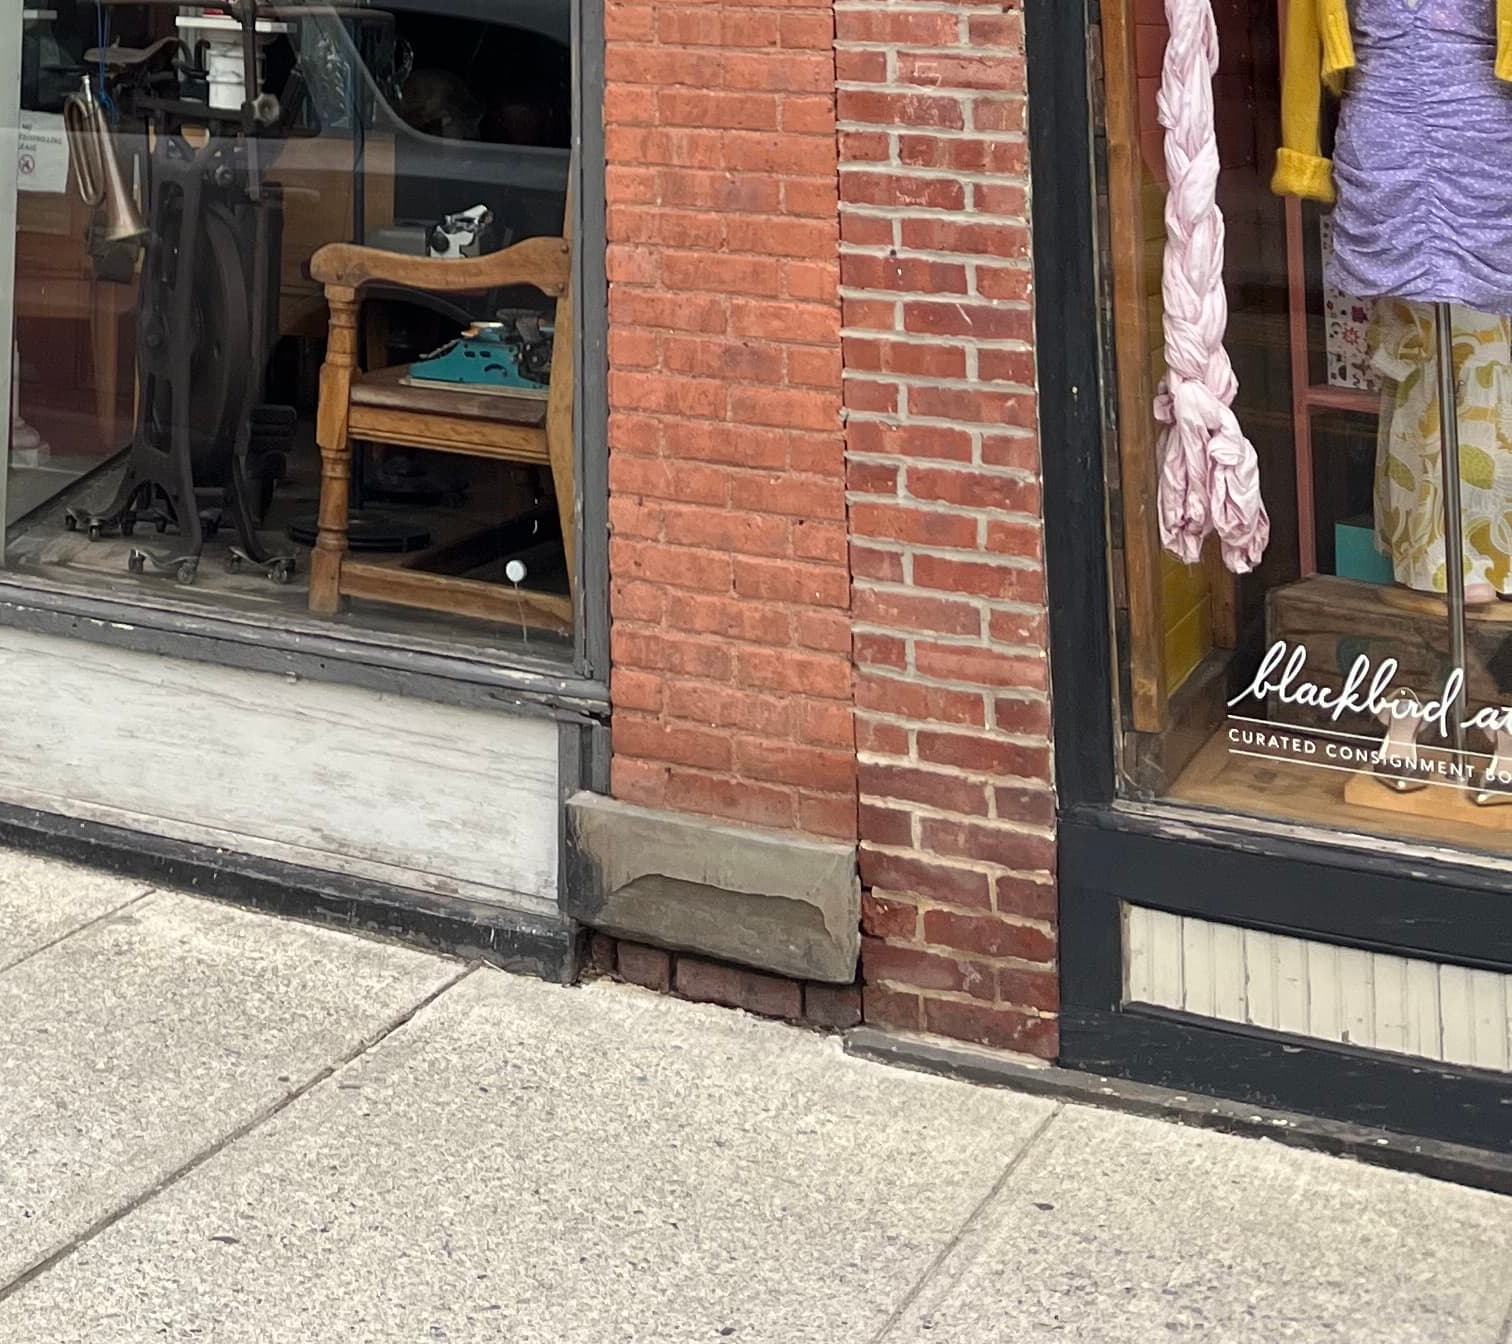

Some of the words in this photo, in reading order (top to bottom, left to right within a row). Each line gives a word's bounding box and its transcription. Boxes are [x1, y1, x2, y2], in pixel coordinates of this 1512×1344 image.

[1227, 640, 1464, 737] blackbird
[1228, 728, 1317, 755] CURATED
[1326, 743, 1476, 779] CONSIGNMENT
